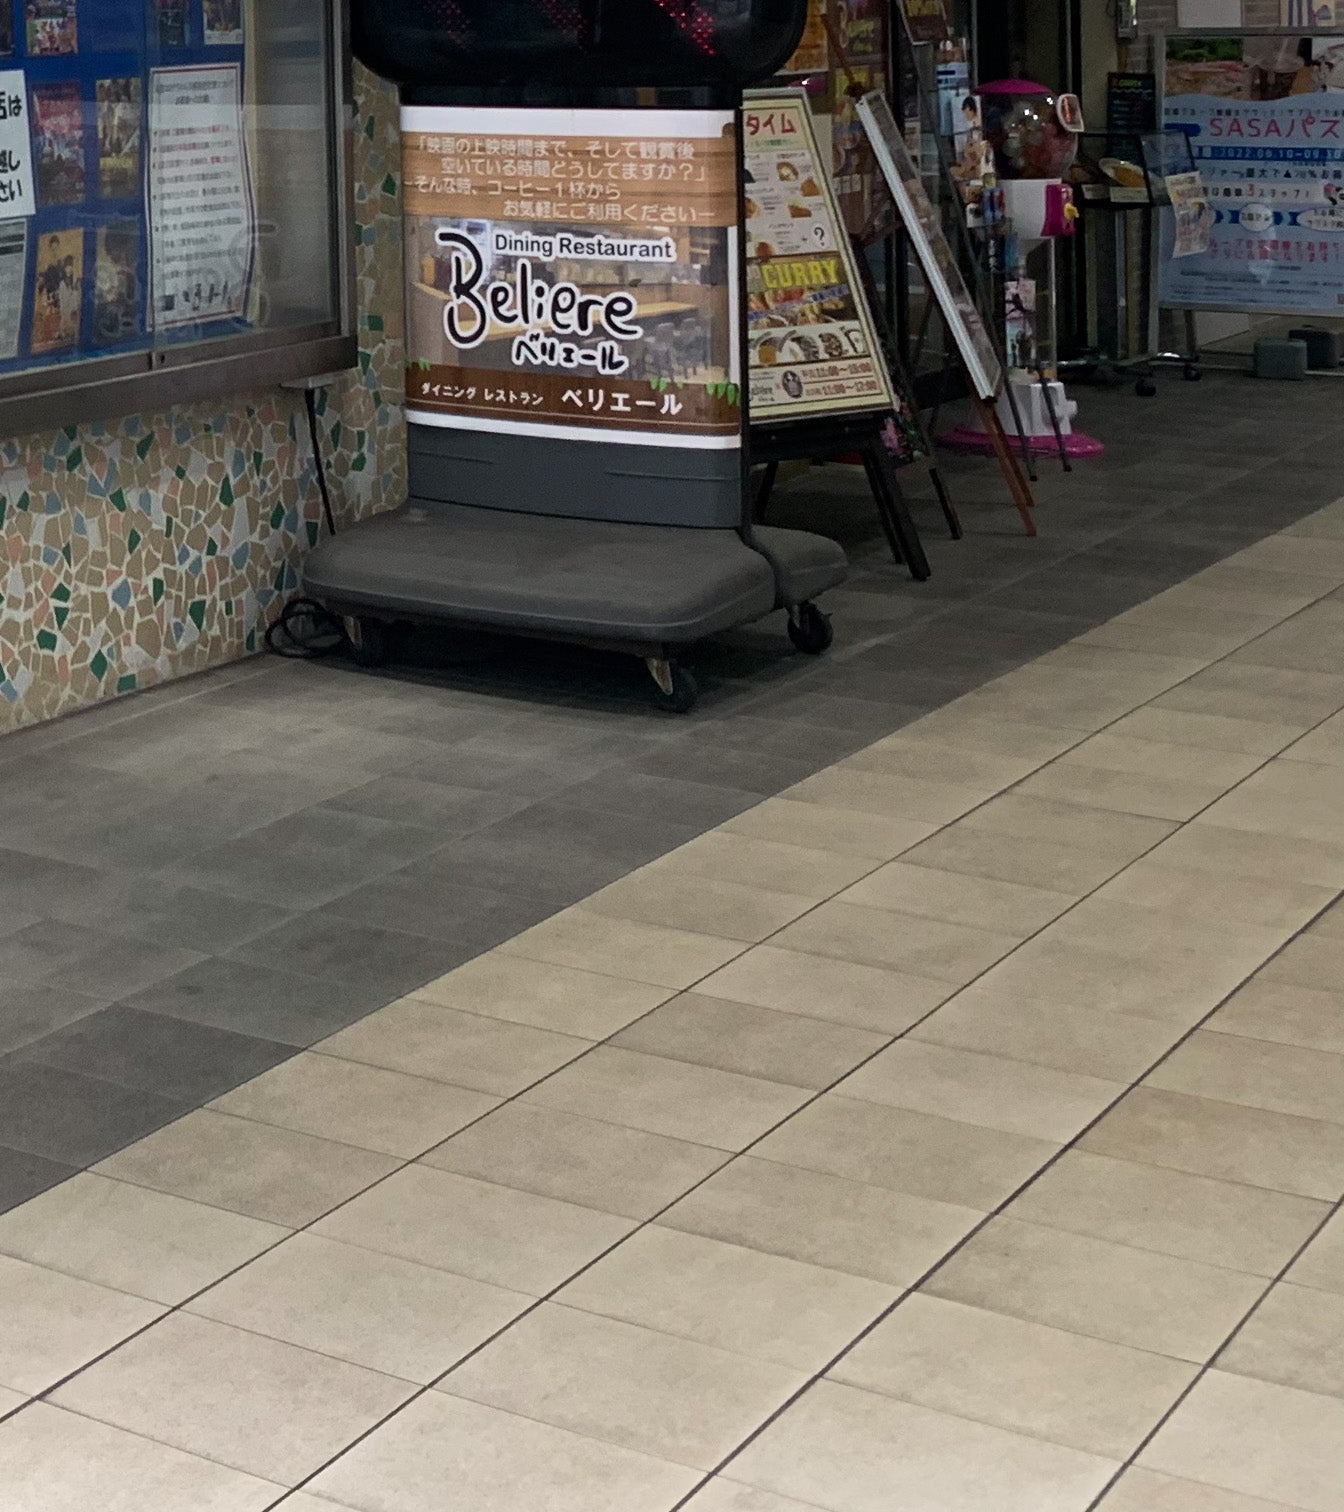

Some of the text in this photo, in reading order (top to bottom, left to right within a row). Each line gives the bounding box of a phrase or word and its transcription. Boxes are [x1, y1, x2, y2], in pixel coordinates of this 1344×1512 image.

[746, 113, 797, 136] タイム
[1209, 115, 1340, 139] SASAパス
[495, 234, 673, 258] Dining Restaurant
[761, 259, 839, 288] CURRY
[515, 332, 625, 370] ベリエール
[420, 382, 683, 417] ダイニング レストラン ベリエール
